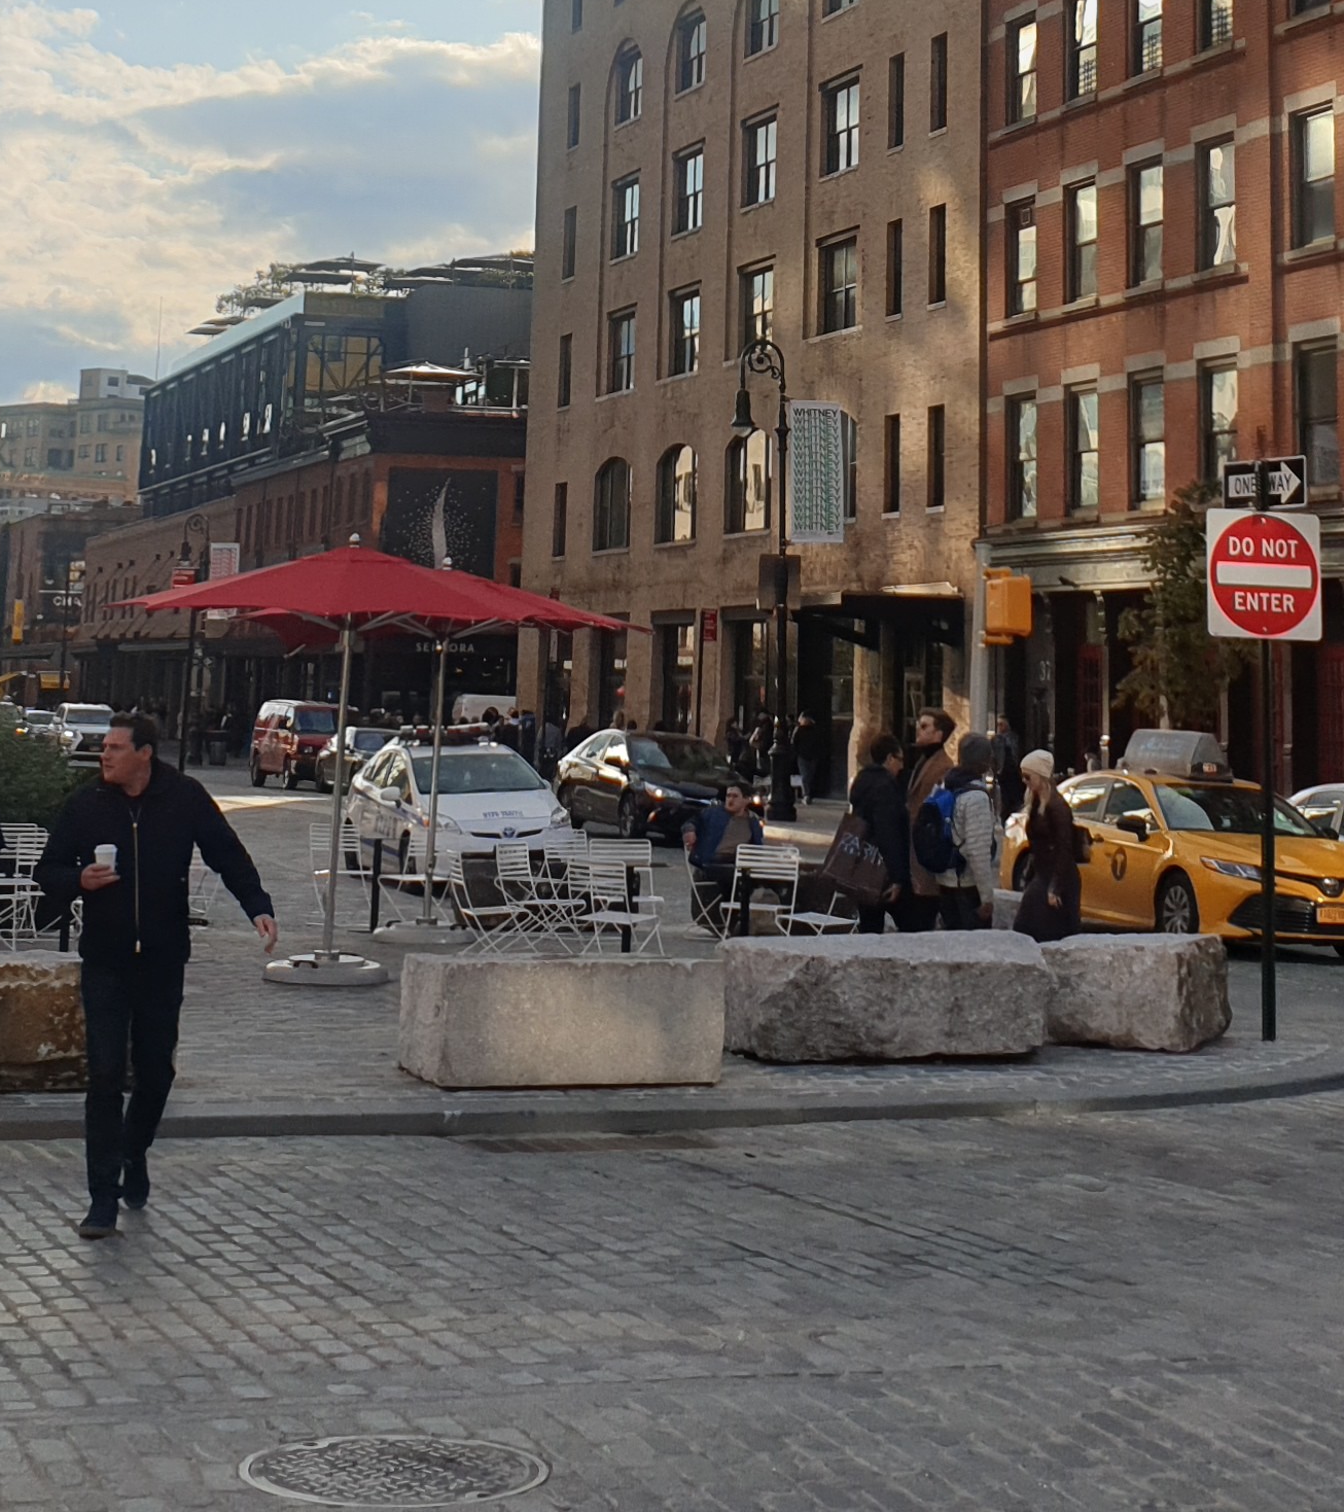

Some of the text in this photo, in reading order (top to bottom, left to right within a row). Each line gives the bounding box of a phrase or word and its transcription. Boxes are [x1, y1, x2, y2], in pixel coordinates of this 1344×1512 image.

[792, 408, 838, 417] WHITNEY
[1234, 473, 1292, 495] ONE WAY
[1228, 535, 1299, 559] DO NOT
[1234, 591, 1295, 613] ENTER
[416, 641, 475, 653] SEORA
